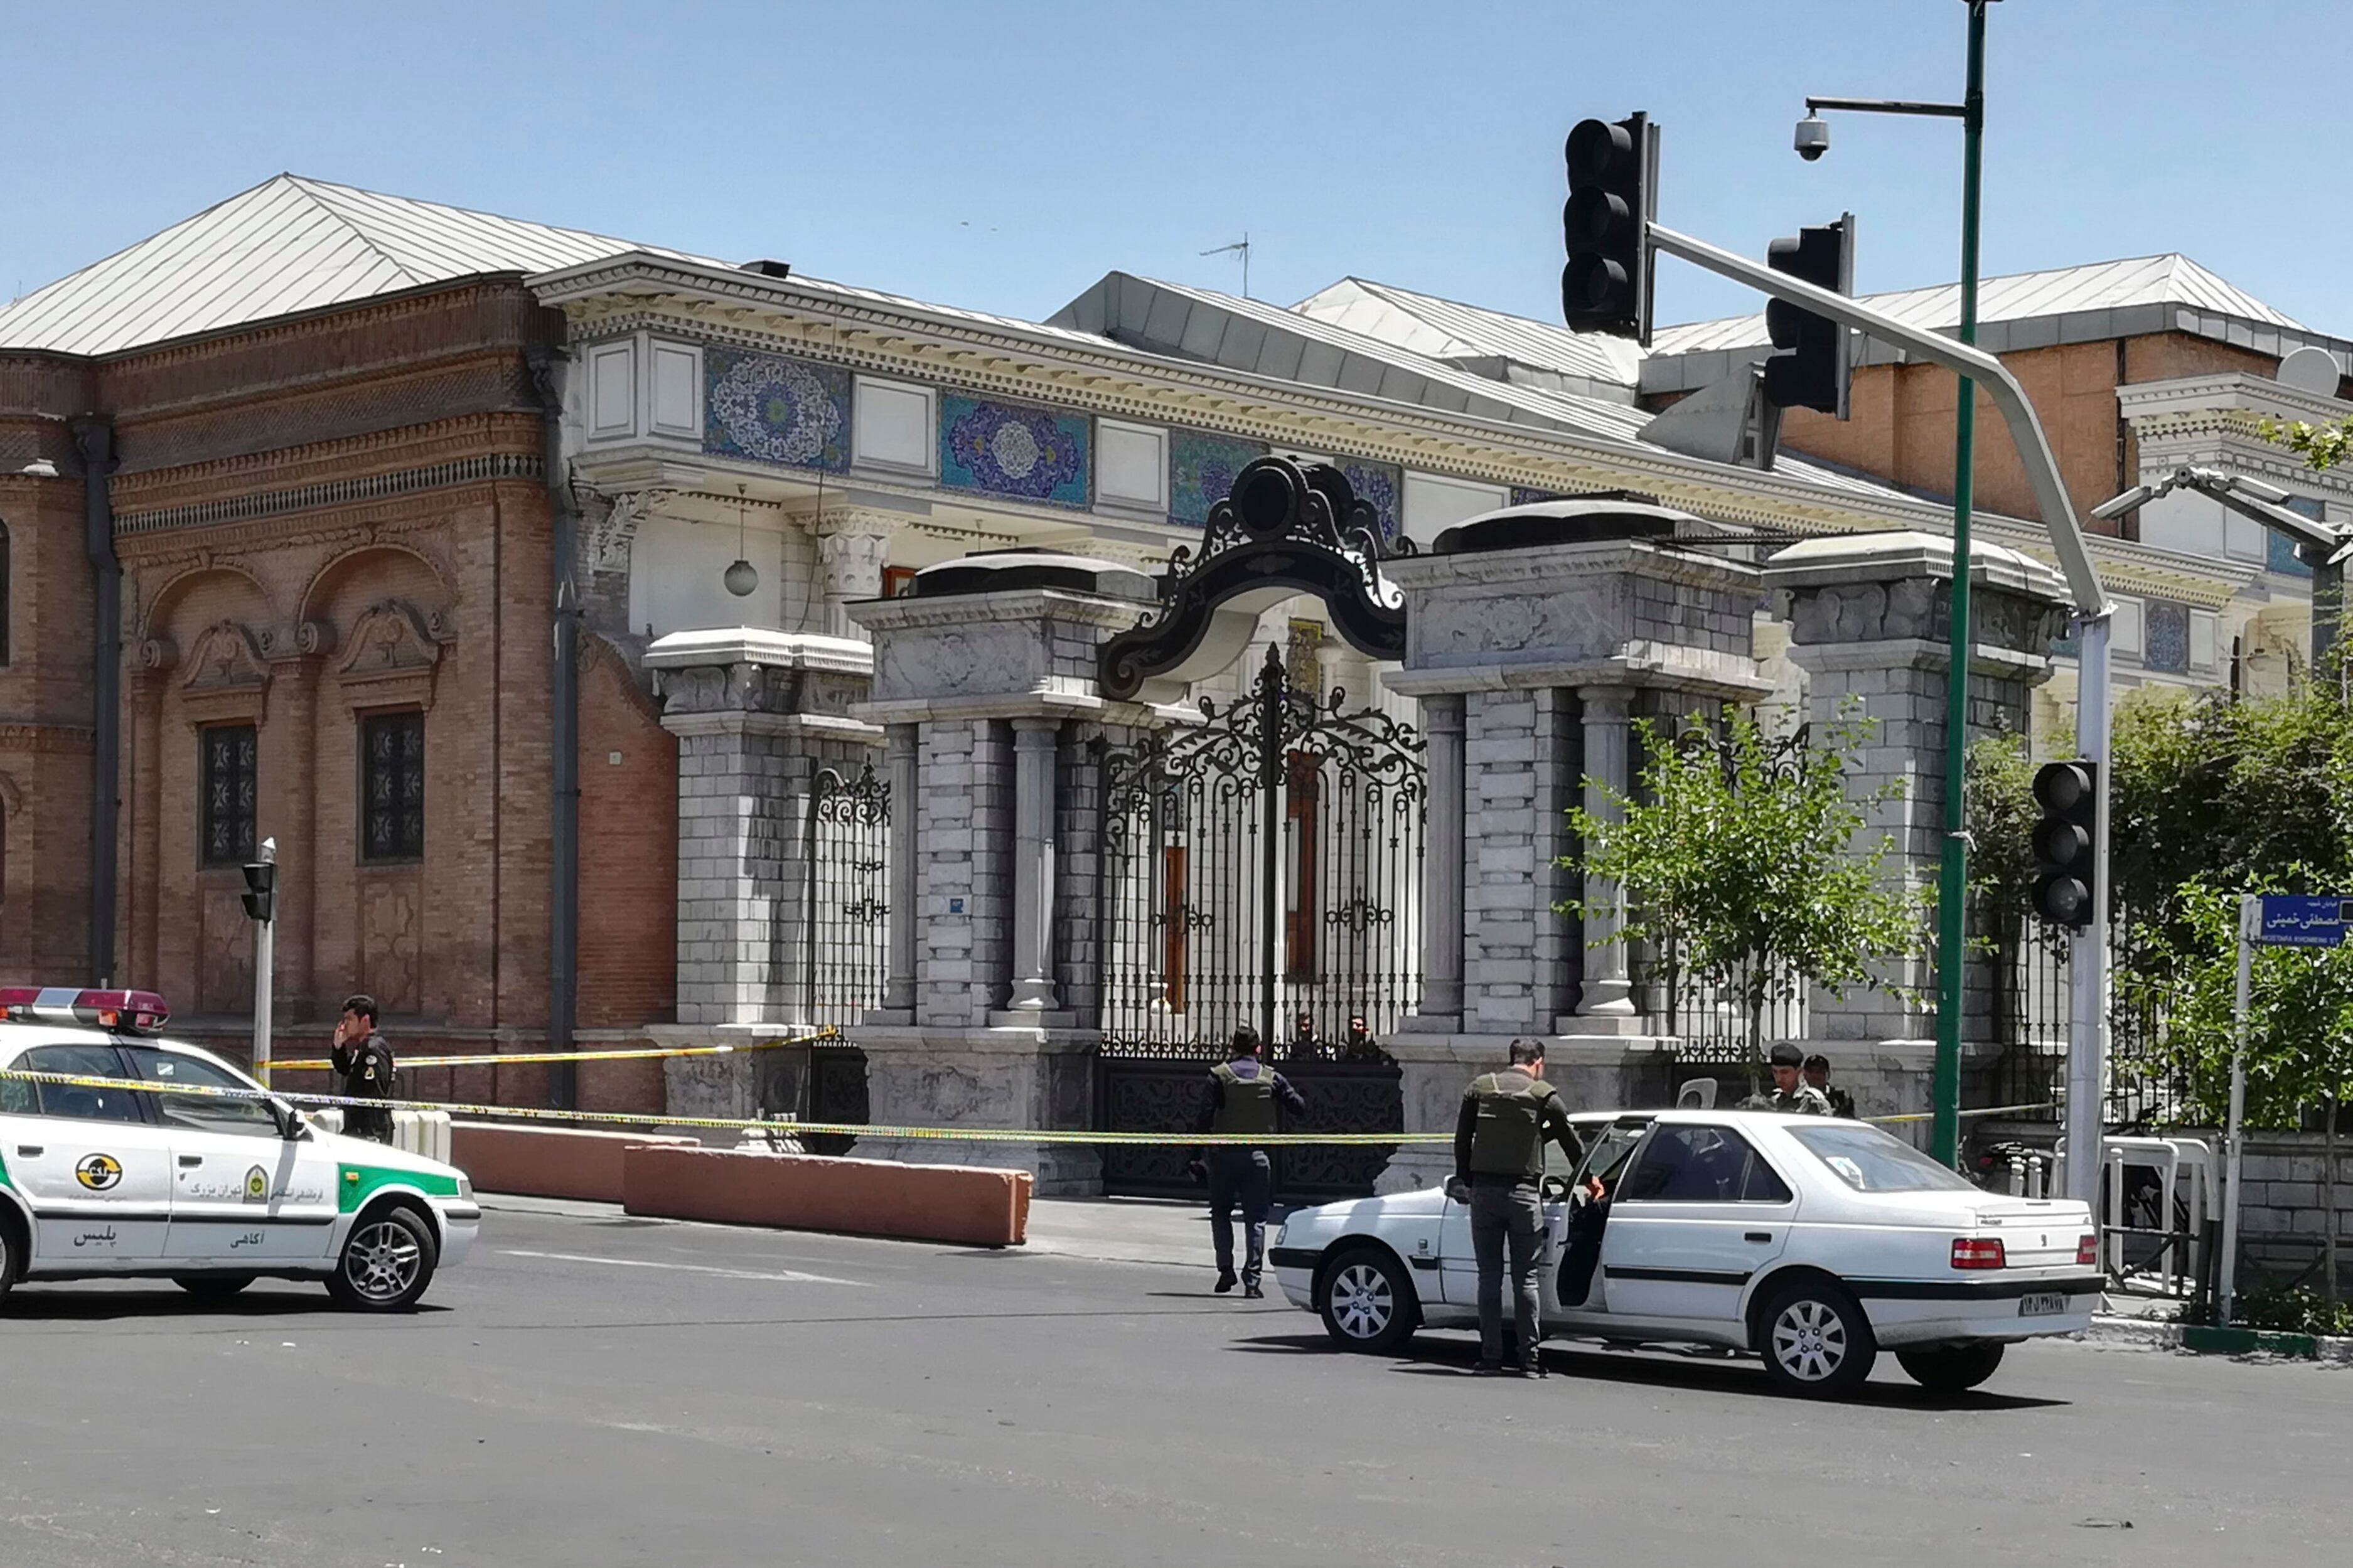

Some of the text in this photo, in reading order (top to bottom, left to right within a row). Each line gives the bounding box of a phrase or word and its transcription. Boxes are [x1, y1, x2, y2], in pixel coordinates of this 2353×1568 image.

[2266, 912, 2340, 930] مصطفی خمینی
[73, 1224, 117, 1248] پلیس
